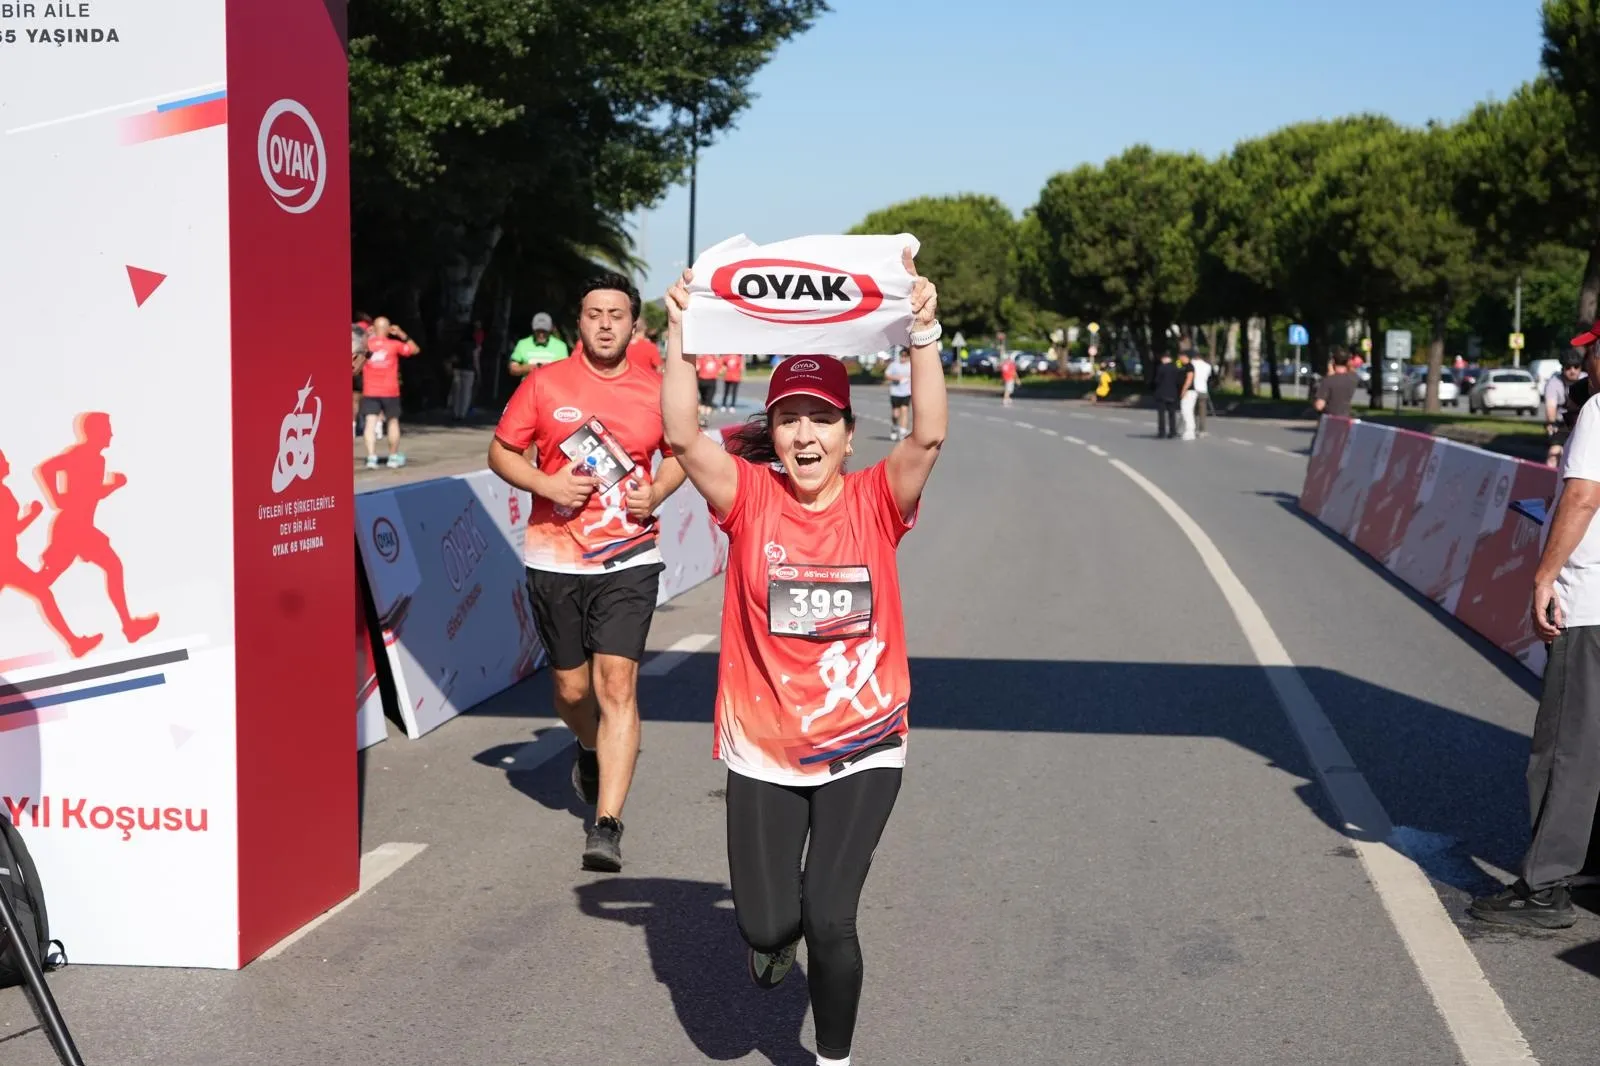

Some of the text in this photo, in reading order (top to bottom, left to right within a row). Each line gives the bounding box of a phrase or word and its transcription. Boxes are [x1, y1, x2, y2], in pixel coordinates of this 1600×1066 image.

[2, 0, 90, 18] BİR AİLE
[0, 28, 120, 47] 5 YAŞINDA
[270, 134, 315, 181] OYAK
[738, 273, 852, 301] OYAK
[258, 495, 335, 520] ÜYELERİ VE ŞİRKETLERİYLE
[293, 518, 303, 534] BİR
[304, 517, 316, 531] AİLE
[272, 542, 289, 557] OYAK
[299, 535, 324, 552] YAŞINDA
[789, 588, 853, 619] 399
[3, 796, 208, 841] Yıl Koşusu
